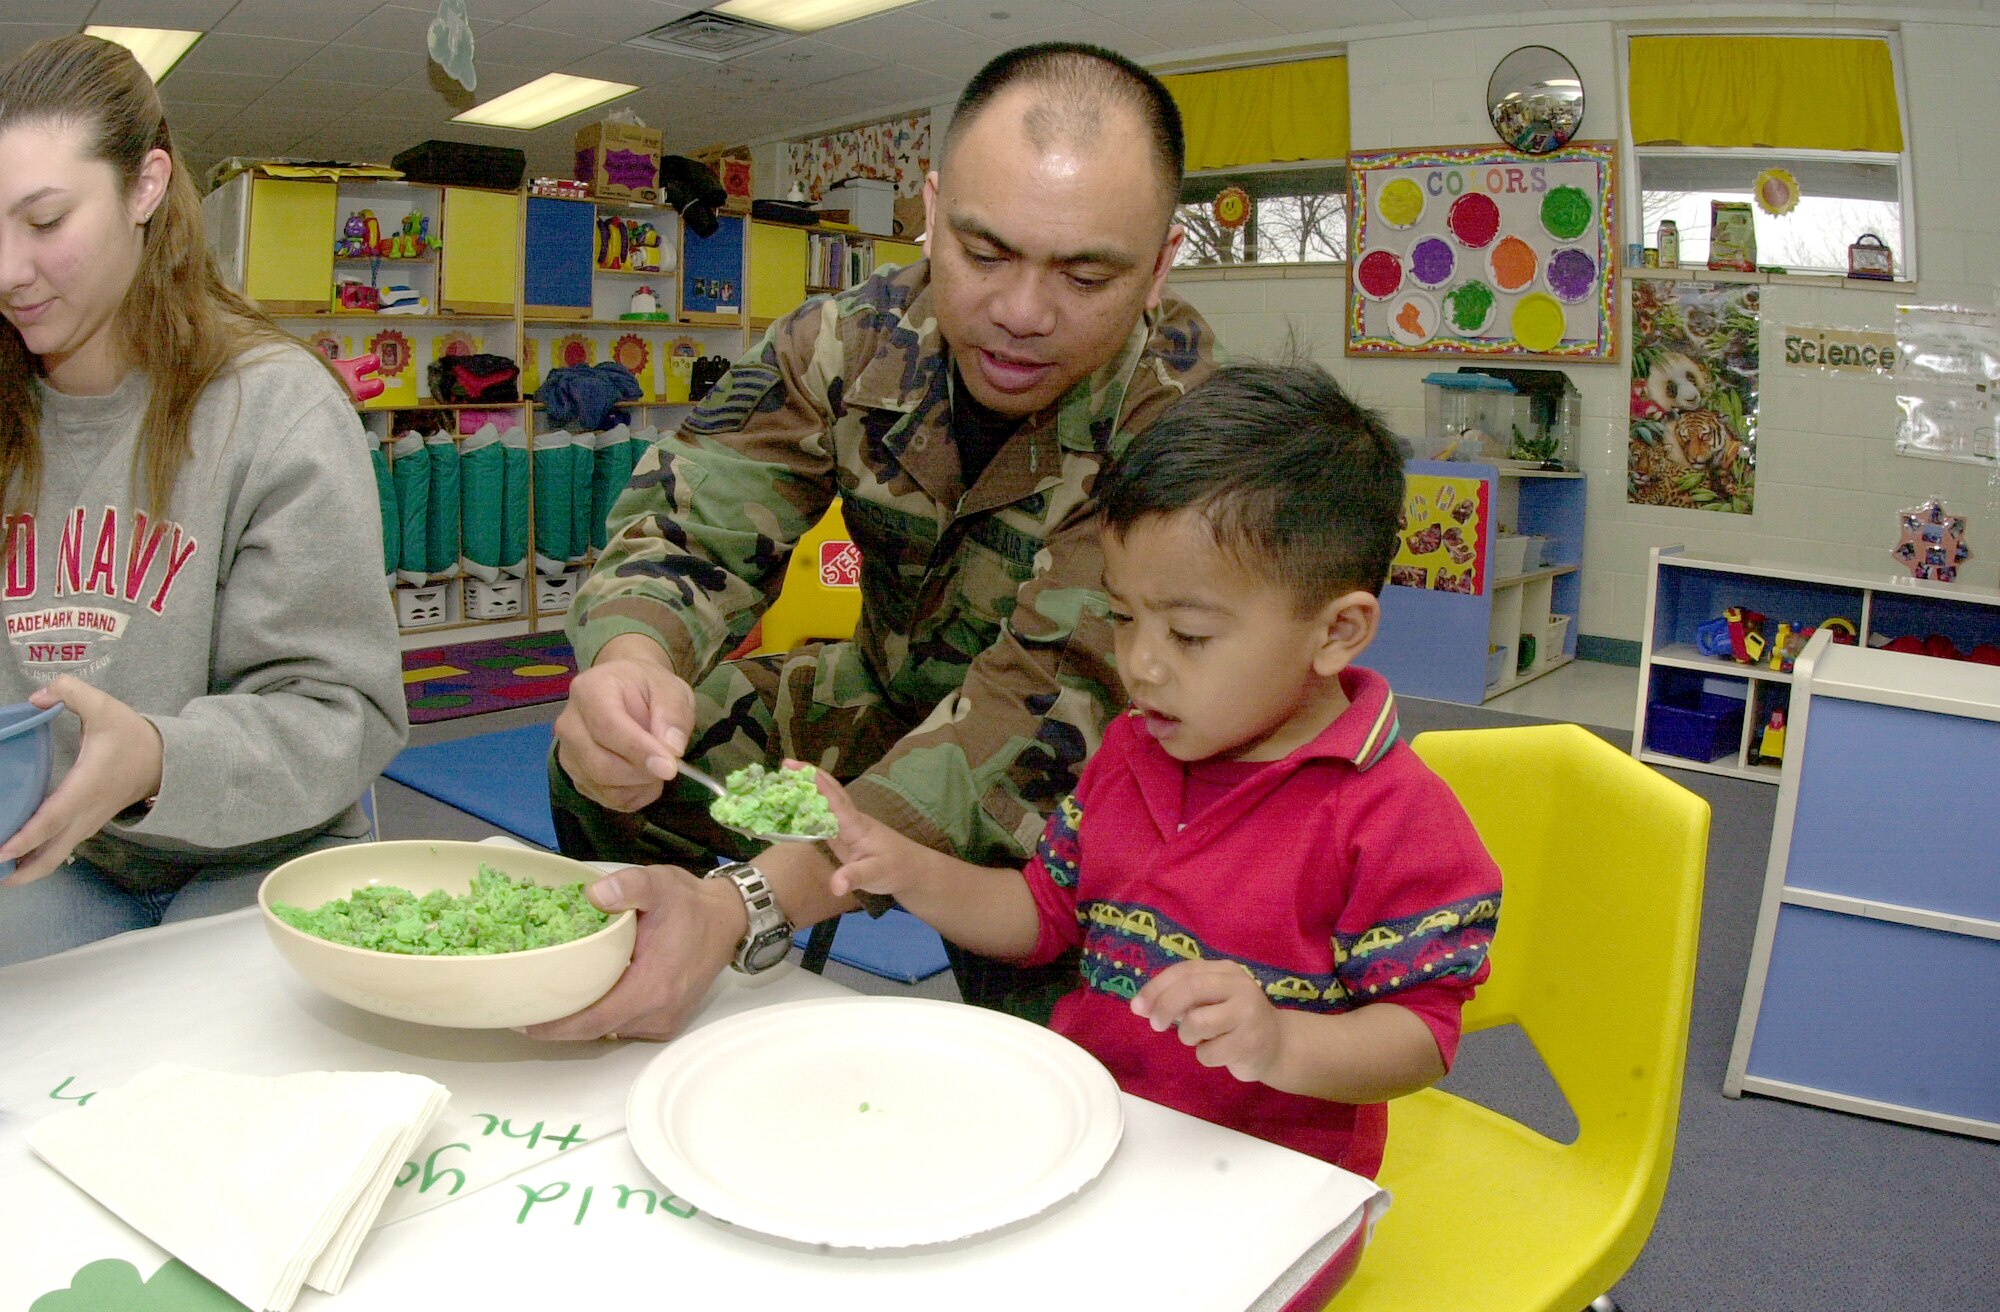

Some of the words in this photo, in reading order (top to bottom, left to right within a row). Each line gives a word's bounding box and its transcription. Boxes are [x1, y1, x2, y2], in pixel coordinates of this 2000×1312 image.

[1427, 167, 1547, 196] COLORS
[1785, 334, 1895, 369] Science
[55, 505, 197, 617] NAVY
[822, 543, 861, 584] STEP
[77, 611, 116, 632] BRAND
[28, 644, 87, 662] NY-SF
[470, 1112, 589, 1152] the
[515, 1181, 699, 1226] ould
